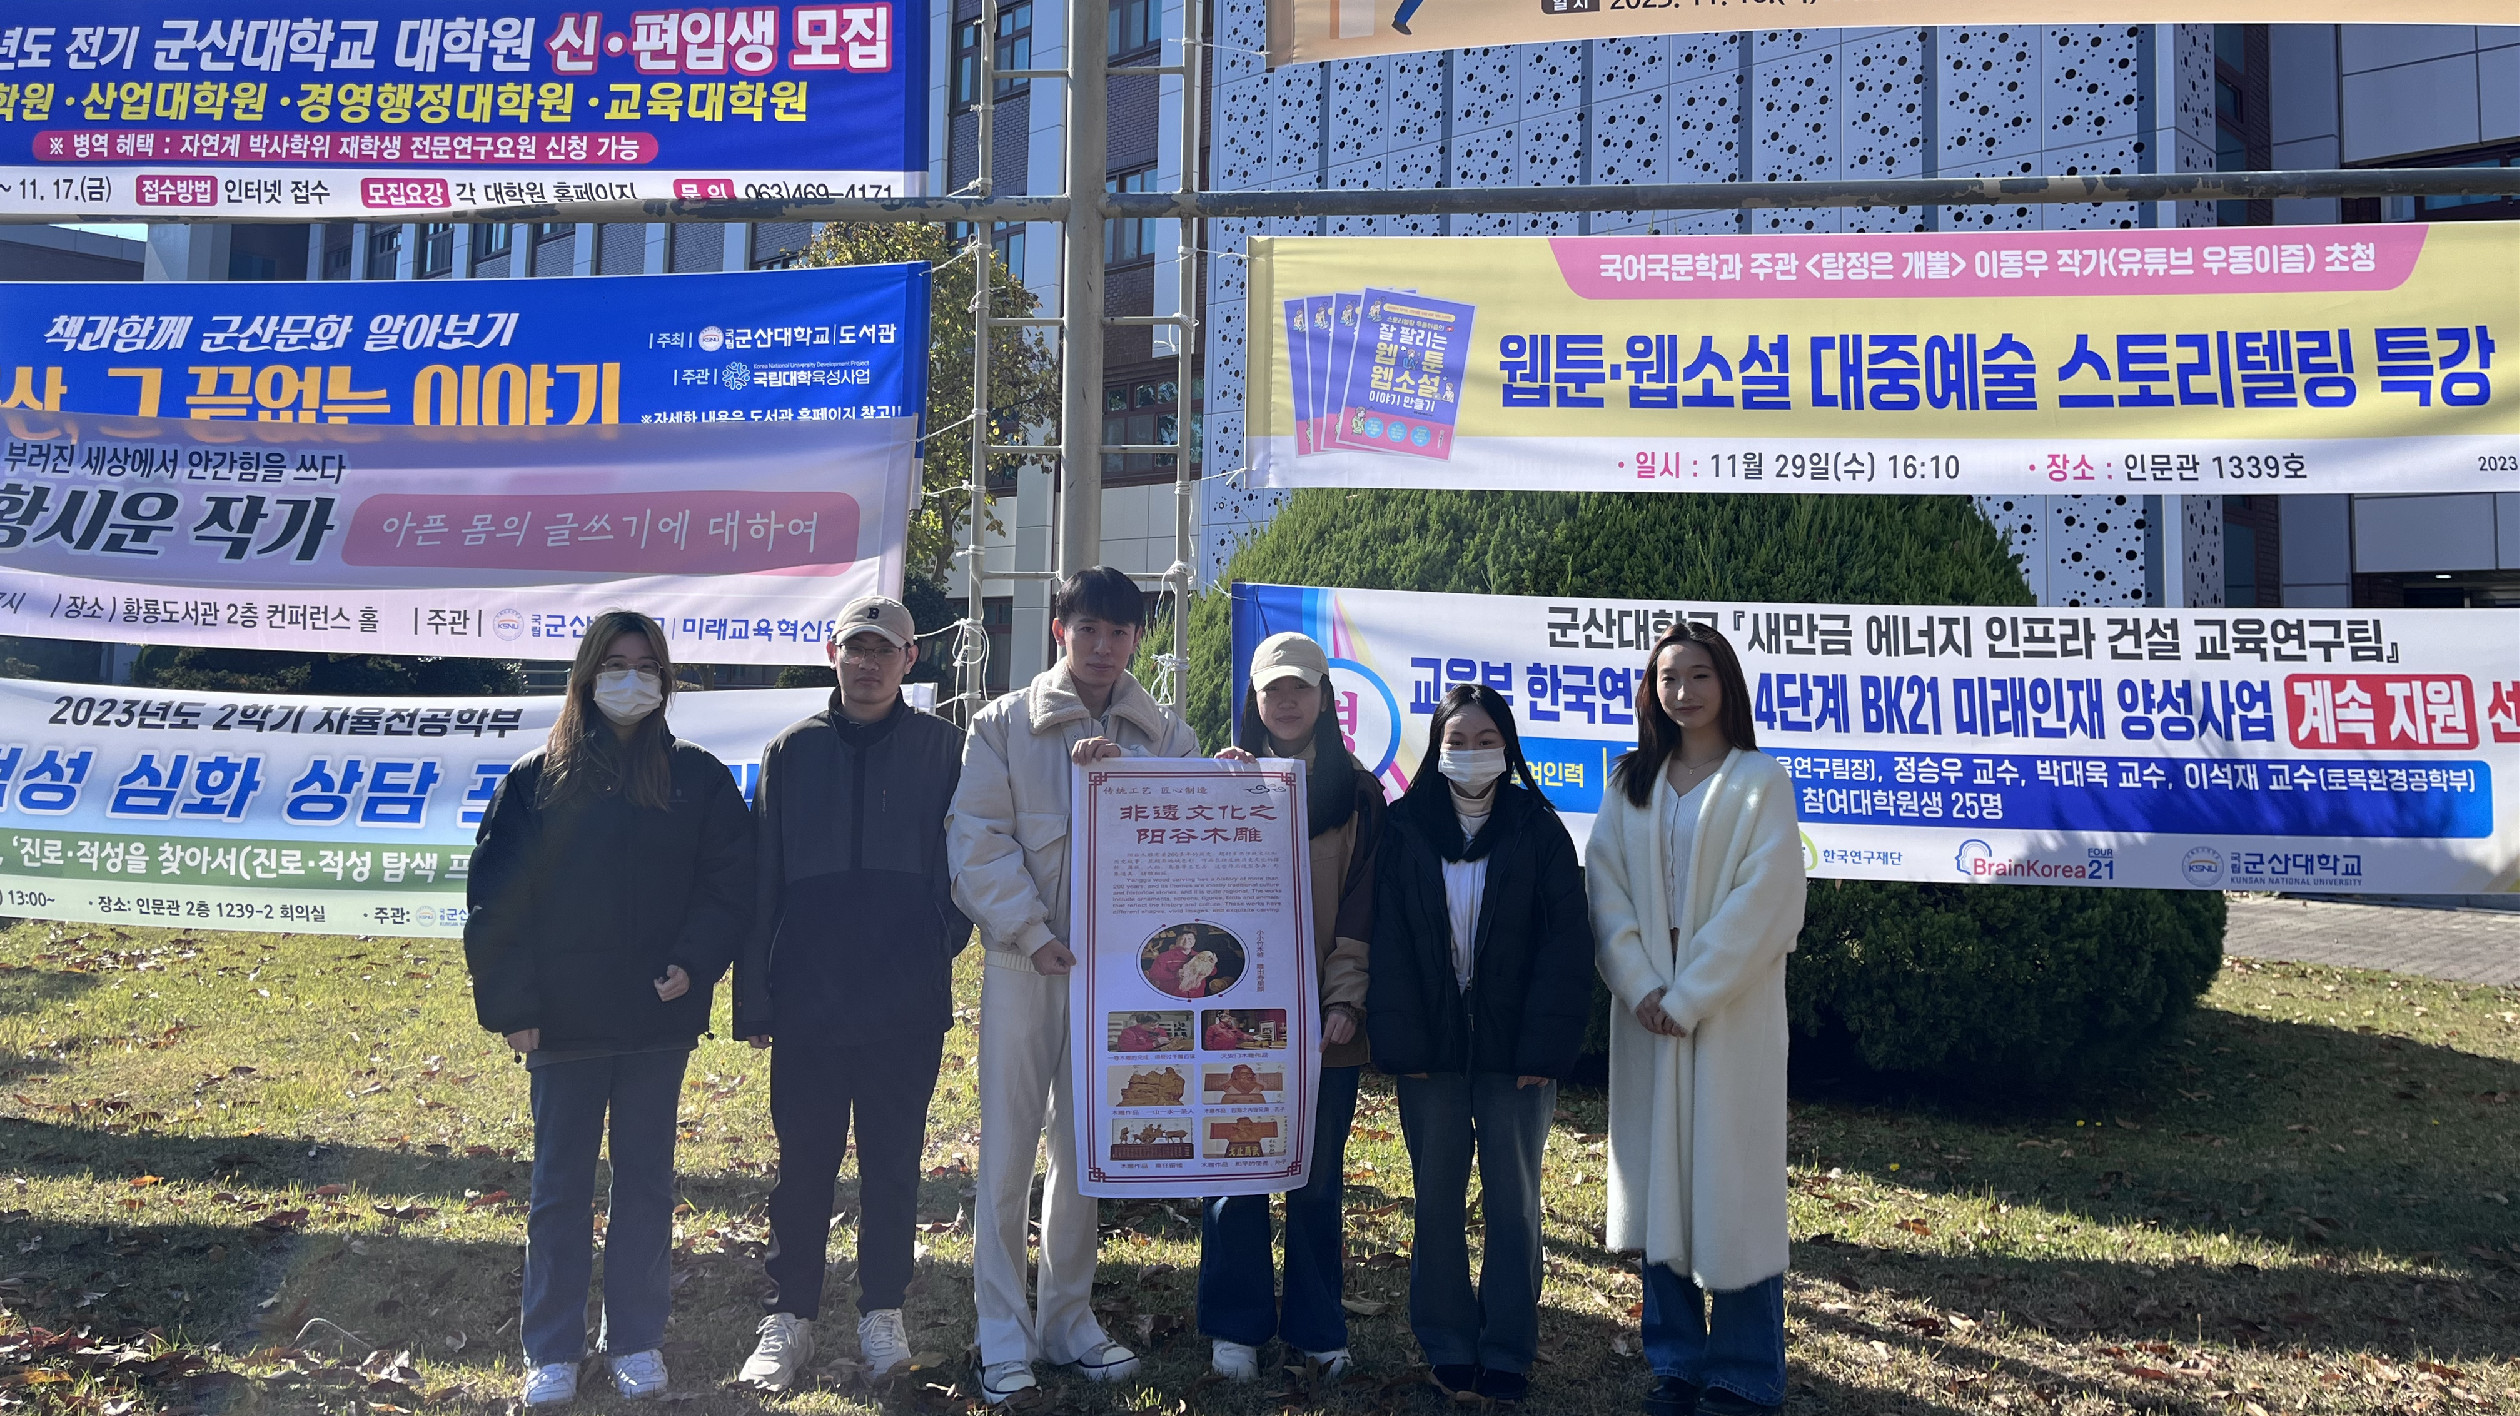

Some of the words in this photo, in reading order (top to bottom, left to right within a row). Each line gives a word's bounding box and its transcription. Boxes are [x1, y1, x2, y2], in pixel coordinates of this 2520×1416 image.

[66, 27, 140, 69] 전기
[153, 18, 380, 72] 군산대학교
[394, 17, 536, 72] 대학원
[793, 8, 887, 68] 모집
[73, 133, 109, 158] 병역
[116, 133, 154, 158] 혜택
[180, 134, 240, 158] 자연계
[249, 134, 330, 159] 박사학위
[339, 134, 401, 159] 재학생
[410, 135, 537, 160] 전문연구요원
[546, 136, 587, 160] 신청
[597, 136, 640, 161] 가능
[53, 176, 112, 203] 17.(금)
[141, 179, 212, 204] 접수방법
[225, 178, 282, 205] 인터넷
[290, 179, 330, 205] 접수
[368, 182, 443, 206] 모집요강
[456, 183, 477, 204] 각
[484, 182, 547, 204] 대학원
[553, 182, 638, 202] 홈페이지
[1600, 253, 1743, 282] 국어국문학과
[1750, 251, 1799, 281] 주관
[1805, 250, 1894, 280] <탐정은
[1902, 249, 1967, 280] 개뿔>
[1975, 249, 2048, 279] 이동우
[2057, 245, 2194, 278] 작가(유튜브
[2203, 243, 2316, 275] 우동이즘)
[2325, 242, 2376, 273] 초청
[44, 314, 193, 353] 책과함께
[202, 314, 353, 352] 군산문화
[363, 312, 520, 352] 알아보기
[657, 332, 685, 349] 주최
[735, 325, 830, 349] 군산대학교
[839, 323, 897, 345] 도서관
[1379, 323, 1397, 342] 잘
[1400, 326, 1448, 350] 팔리는
[682, 368, 710, 386] 주관
[753, 367, 870, 387] 국립대학육성사업
[1370, 366, 1441, 398] 웹소설
[1500, 333, 1792, 411] 웹툰·웹소설
[1811, 333, 2038, 411] 대중예술
[2058, 329, 2357, 408] 스토리텔링
[2374, 325, 2496, 407] 특강
[413, 362, 621, 440] 이야기
[1369, 390, 1401, 407] 이야기
[1403, 394, 1436, 412] 만들기
[4, 441, 75, 474] 부러진
[81, 446, 179, 479] 세상에서
[188, 450, 287, 483] 안간힘을
[296, 454, 346, 485] 쓰다
[1635, 451, 1682, 480] 일시
[1711, 454, 1764, 480] 11월
[1775, 451, 1876, 483] 29일(수)
[1889, 454, 1960, 480] 16:10
[2047, 453, 2096, 482] 장소
[2124, 452, 2201, 482] 인문관
[2211, 453, 2308, 481] 1339호
[0, 483, 179, 556] 황시운
[194, 491, 336, 561] 작가
[382, 512, 449, 549] 아픈
[462, 511, 532, 548] 몸의
[544, 507, 690, 551] 글쓰기에
[708, 509, 819, 554] 대하여
[64, 596, 104, 619] 장소
[123, 597, 218, 627] 황룡도서관
[227, 603, 259, 629] 2층
[266, 606, 351, 631] 컨퍼런스
[358, 607, 380, 633] 홀
[426, 609, 470, 637] 주관
[867, 607, 880, 619] B
[1866, 614, 1972, 658] 에너지
[1986, 615, 2096, 660] 인프라
[2107, 617, 2181, 661] 건설
[49, 696, 206, 731] 2023년도
[211, 703, 306, 734] 2학기
[312, 705, 523, 739] 자율전공학부
[1754, 672, 1851, 734] 4단계
[1860, 673, 1943, 736] BK21
[1953, 676, 2106, 740] 미래인재
[2117, 676, 2276, 743] 양성사업
[2292, 679, 2377, 745] 계속
[2386, 679, 2470, 745] 지원
[109, 754, 262, 819] 심화
[286, 758, 440, 825] 상담
[1893, 756, 1964, 785] 정승우
[1972, 758, 2026, 788] 교수,
[2036, 760, 2109, 788] 박대욱
[2118, 761, 2172, 790] 교수,
[2184, 762, 2260, 791] 이석재
[2268, 764, 2476, 793] 교수(토목환경공학부)
[1120, 804, 1277, 822] 非遗文化之
[1802, 786, 1944, 819] 참여대학원생
[1951, 791, 2004, 820] 25명
[1136, 827, 1263, 844] 阳谷木雕
[159, 841, 372, 881] 찾아서(진로·적성
[382, 852, 438, 882] 탐색
[1823, 848, 1903, 867] 한국연구재단
[2088, 848, 2113, 857] FOUR
[2188, 863, 2217, 873] KSNU
[2243, 852, 2363, 877] 군산대학교
[1973, 856, 2087, 880] BrainKorea
[2087, 859, 2115, 881] 21
[2230, 877, 2266, 885] KUNSAN
[2268, 877, 2311, 886] NATIONAL
[2313, 877, 2363, 887] UNIVERSITY
[98, 896, 131, 913] 장소:
[136, 898, 181, 919] 인문관
[185, 900, 211, 920] 2층
[216, 902, 274, 921] 1239-2
[280, 903, 326, 923] 회의실
[374, 907, 411, 925] 주관:
